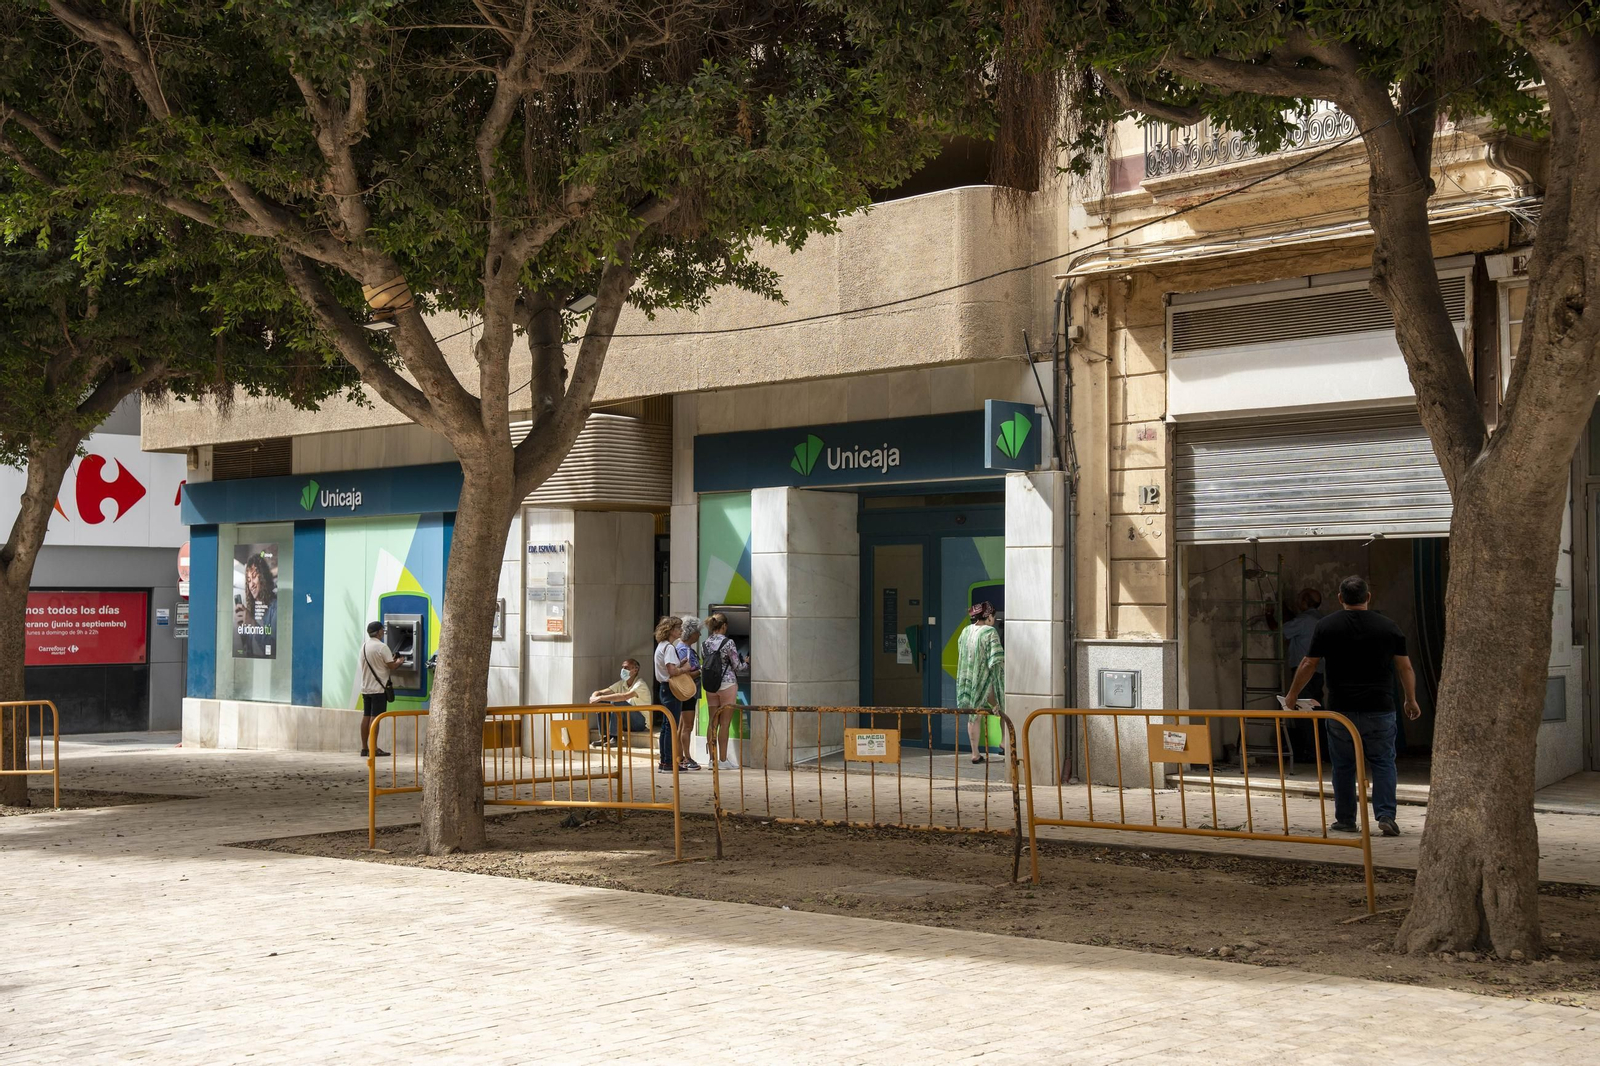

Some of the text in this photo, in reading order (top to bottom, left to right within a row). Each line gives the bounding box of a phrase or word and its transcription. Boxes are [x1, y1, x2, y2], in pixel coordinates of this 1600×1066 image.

[827, 443, 900, 474] Unicaja
[320, 488, 362, 510] Unicaja
[1141, 486, 1159, 504] 12
[48, 606, 77, 615] todos
[81, 606, 96, 614] los
[98, 605, 120, 614] días
[82, 620, 126, 628] septiembre)
[238, 624, 271, 634] el idioma tú
